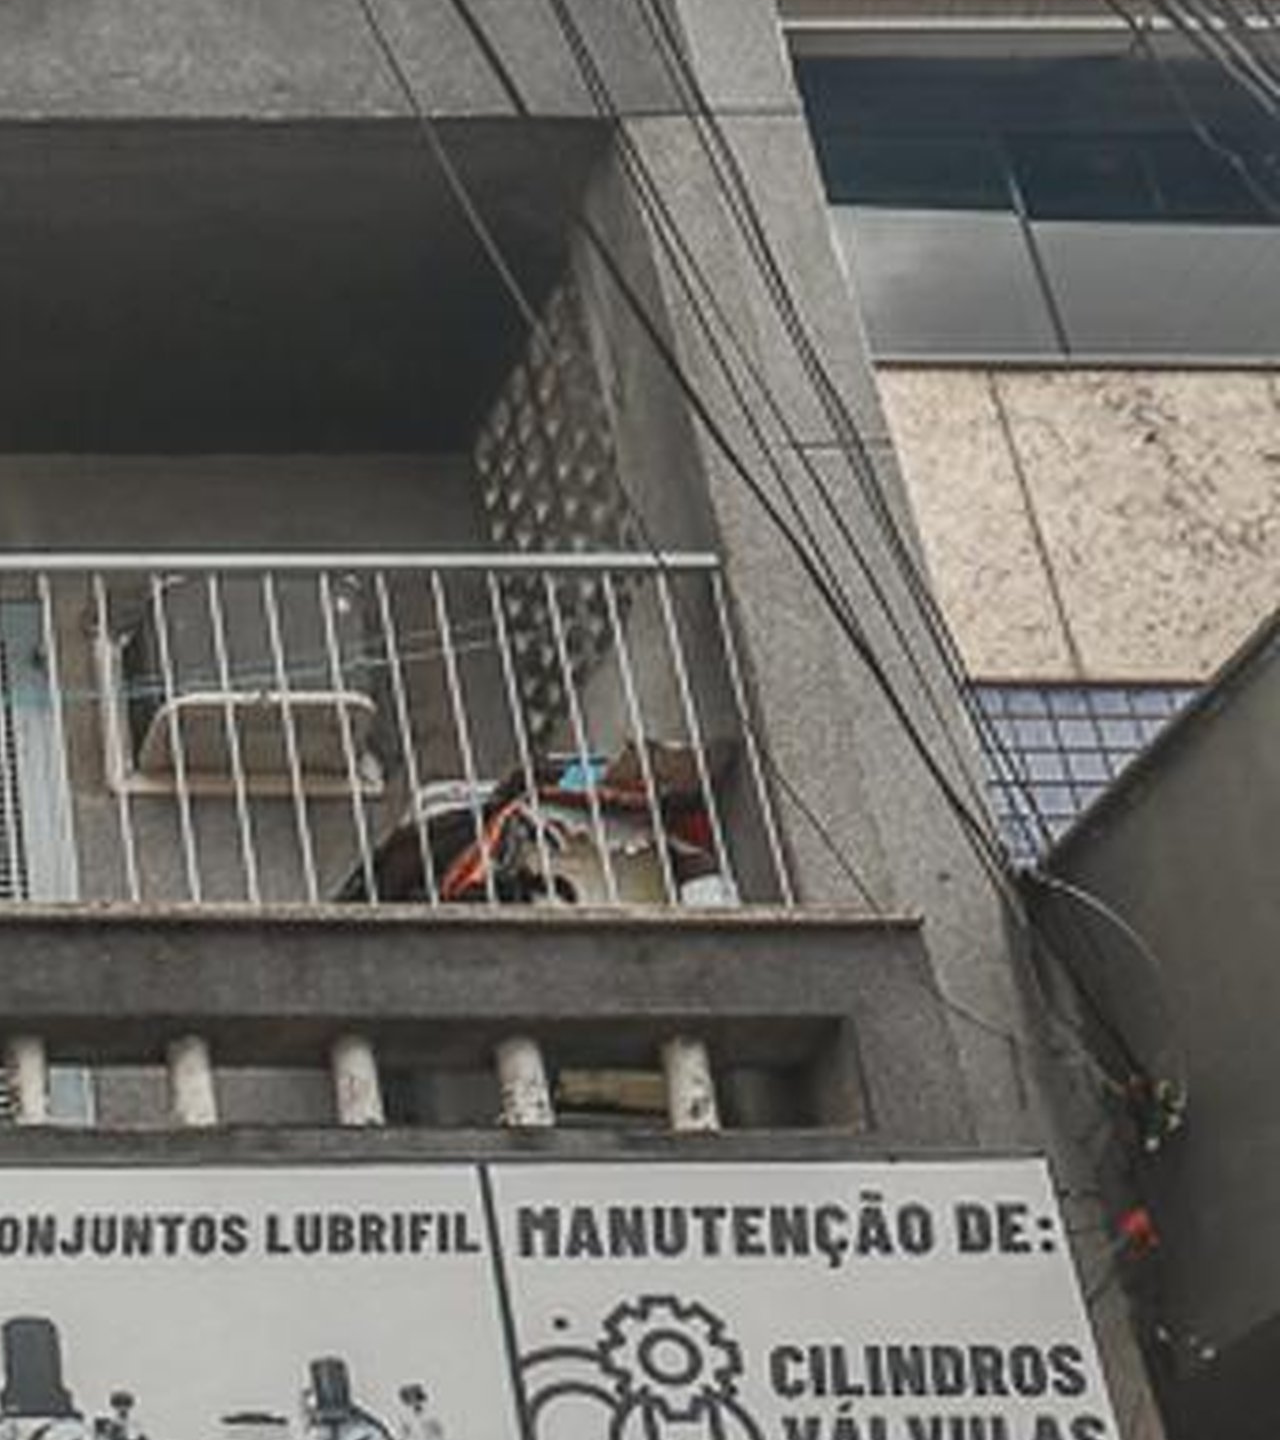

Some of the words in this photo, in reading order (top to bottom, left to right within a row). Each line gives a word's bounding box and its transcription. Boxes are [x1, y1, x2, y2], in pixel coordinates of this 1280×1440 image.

[265, 1212, 481, 1254] LUBRIFIL
[517, 1191, 934, 1267] MANUTENÇÃO
[957, 1203, 1056, 1253] DE:
[771, 1345, 1087, 1397] CILINDROS
